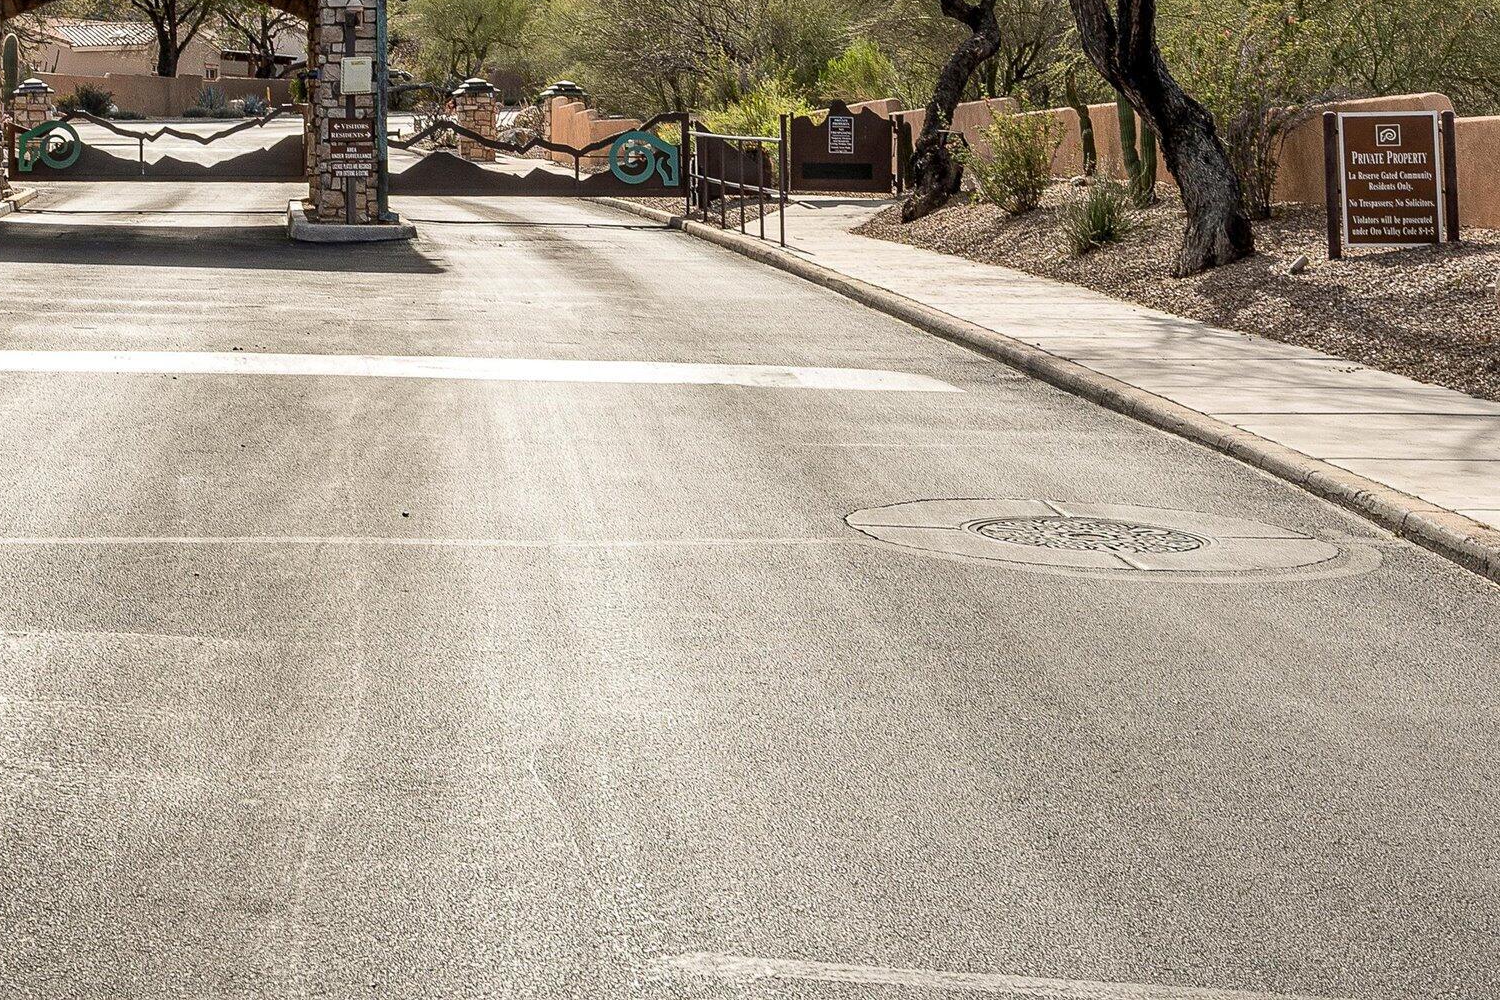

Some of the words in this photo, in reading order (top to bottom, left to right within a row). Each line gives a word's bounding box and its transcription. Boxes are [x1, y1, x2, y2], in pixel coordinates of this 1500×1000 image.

[1351, 150, 1385, 164] PRIVATE
[1386, 150, 1427, 164] PROPERTY
[1348, 171, 1356, 180] La
[1357, 171, 1380, 180] Reserve
[1380, 171, 1398, 180] Gated
[1399, 170, 1432, 180] Community
[1368, 181, 1396, 190] Residents
[1396, 181, 1413, 191] Only.
[1349, 199, 1358, 207] No
[1395, 198, 1404, 207] No
[1352, 215, 1380, 224] Violators
[1380, 215, 1392, 224] will
[1393, 215, 1401, 224] be
[1402, 215, 1432, 225] prosecuted
[1352, 227, 1368, 236] under
[1370, 227, 1382, 236] Oro
[1382, 227, 1401, 237] Valley
[1402, 227, 1417, 236] Code
